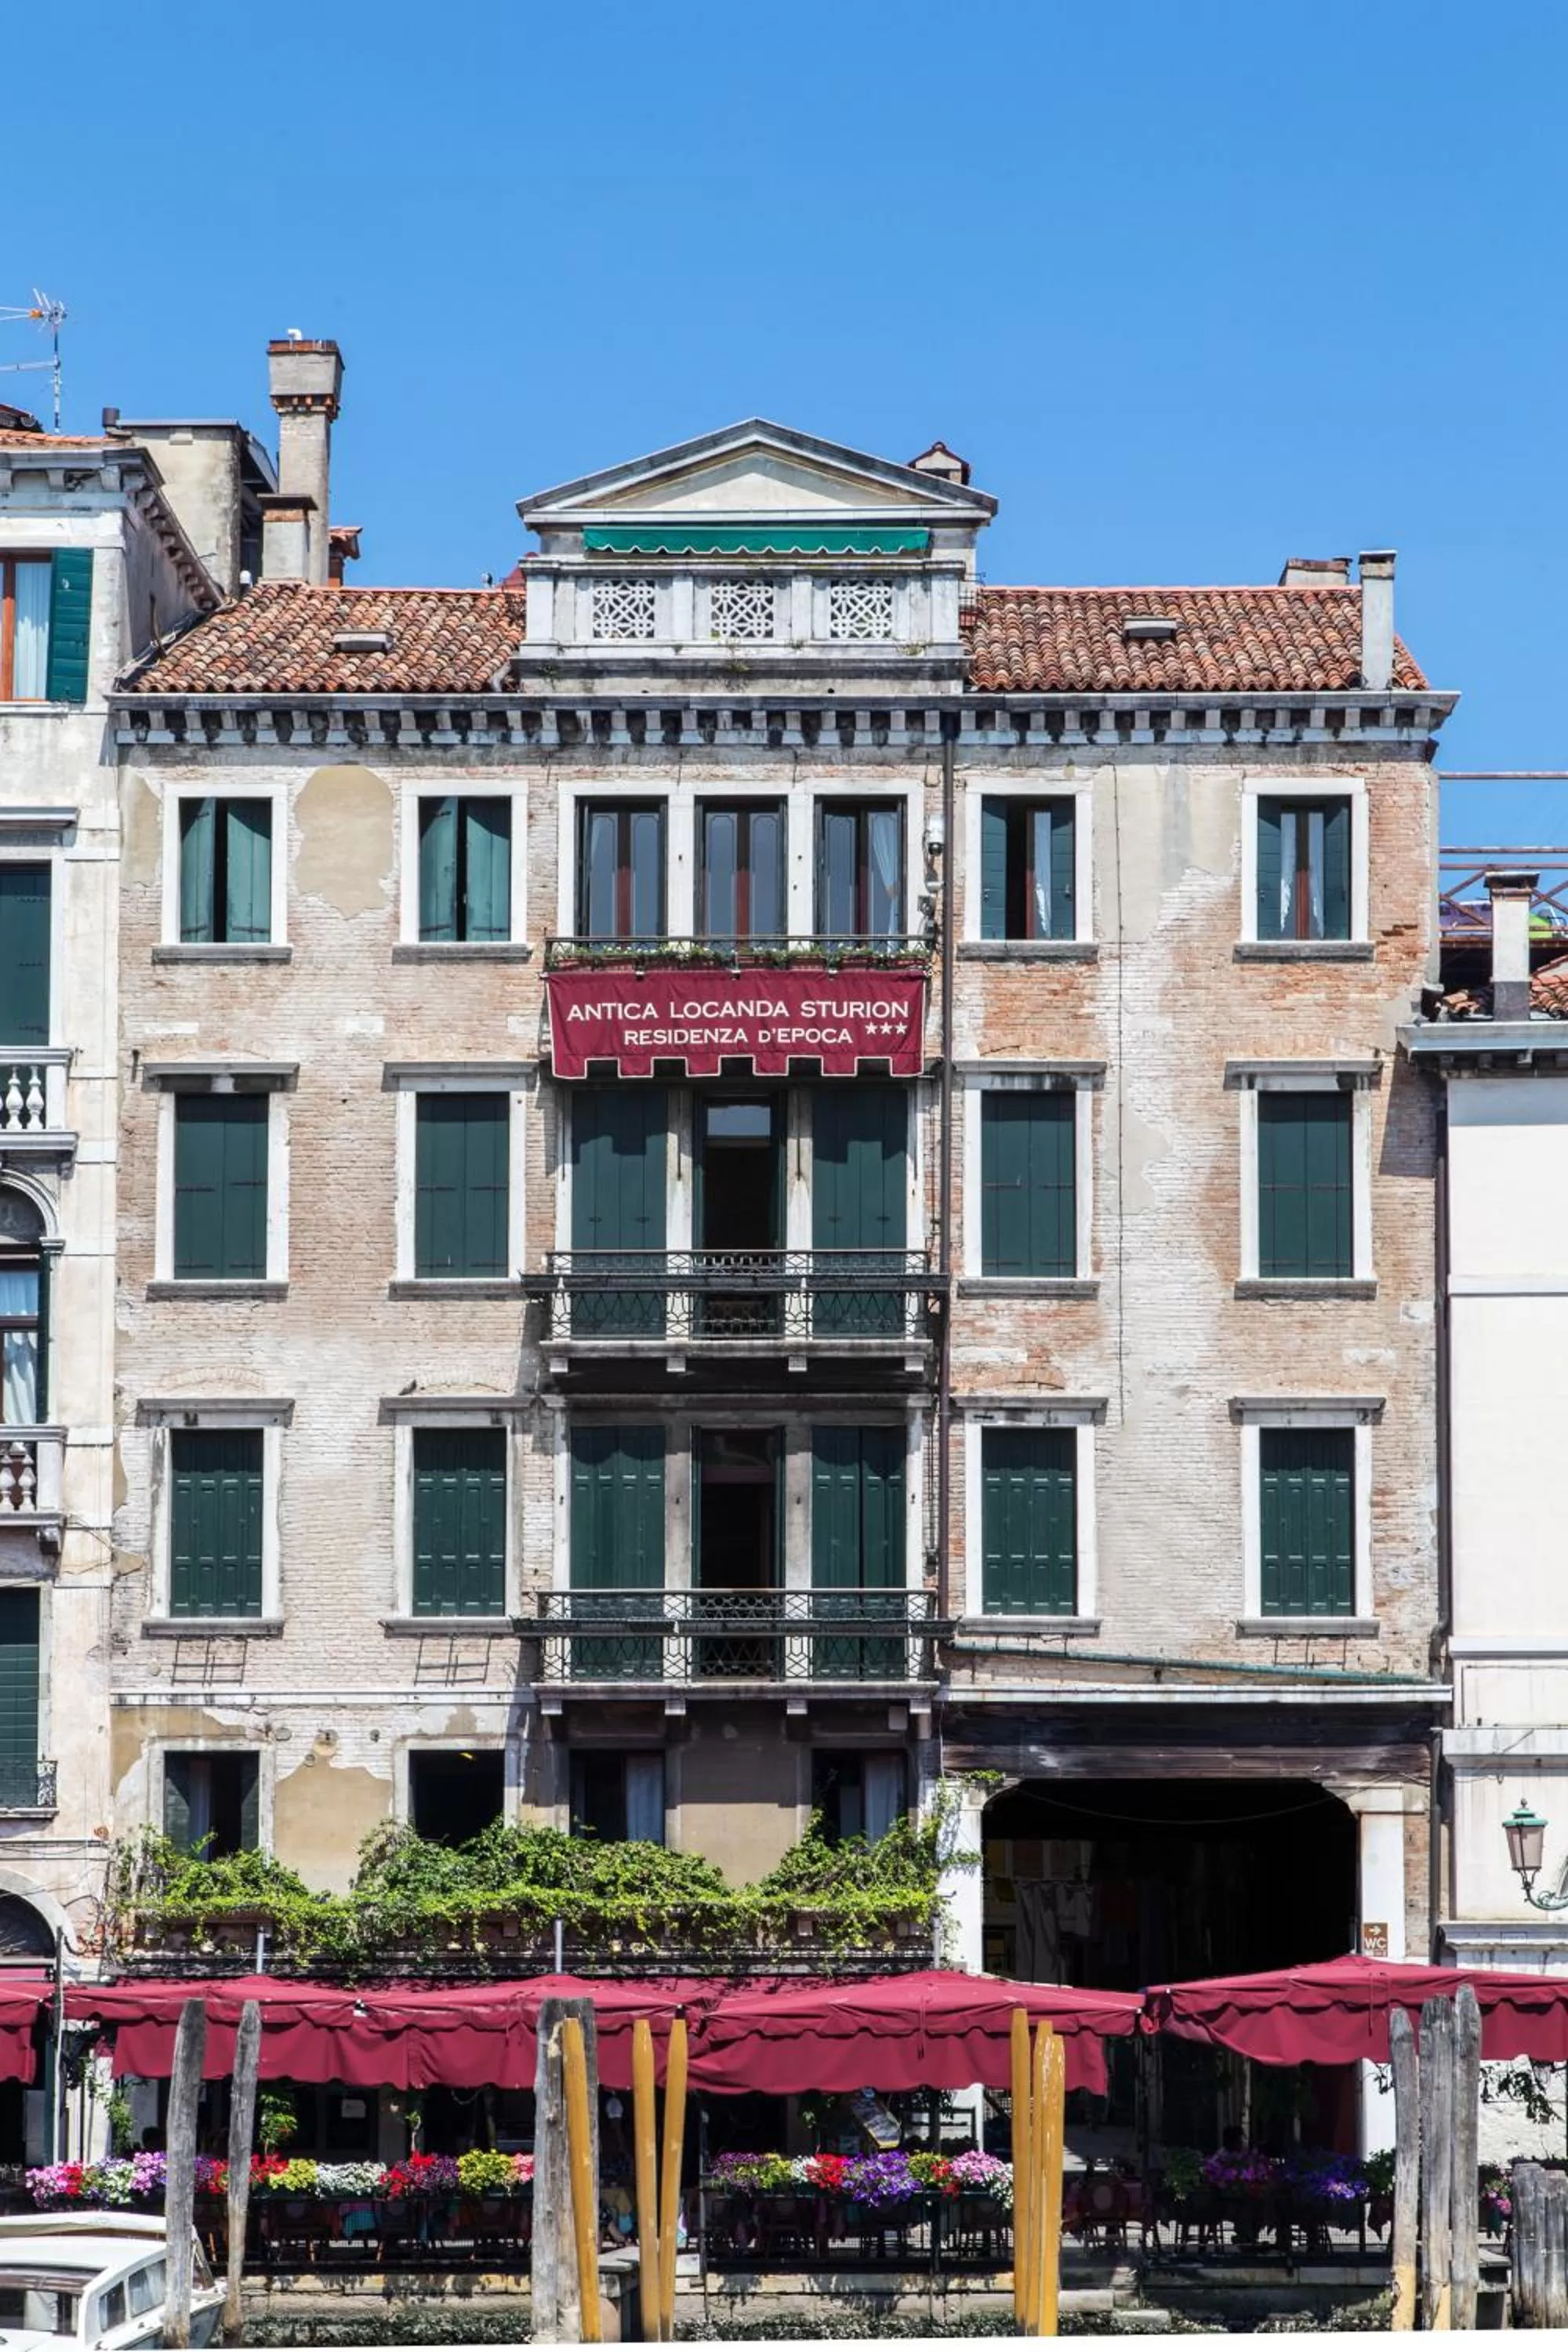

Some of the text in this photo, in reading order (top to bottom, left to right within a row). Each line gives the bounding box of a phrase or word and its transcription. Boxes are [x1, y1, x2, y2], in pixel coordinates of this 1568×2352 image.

[567, 1000, 909, 1022] ANTICA LOCANDA STURION
[623, 1028, 749, 1045] RESIDENZA
[1365, 1936, 1387, 1949] WC
